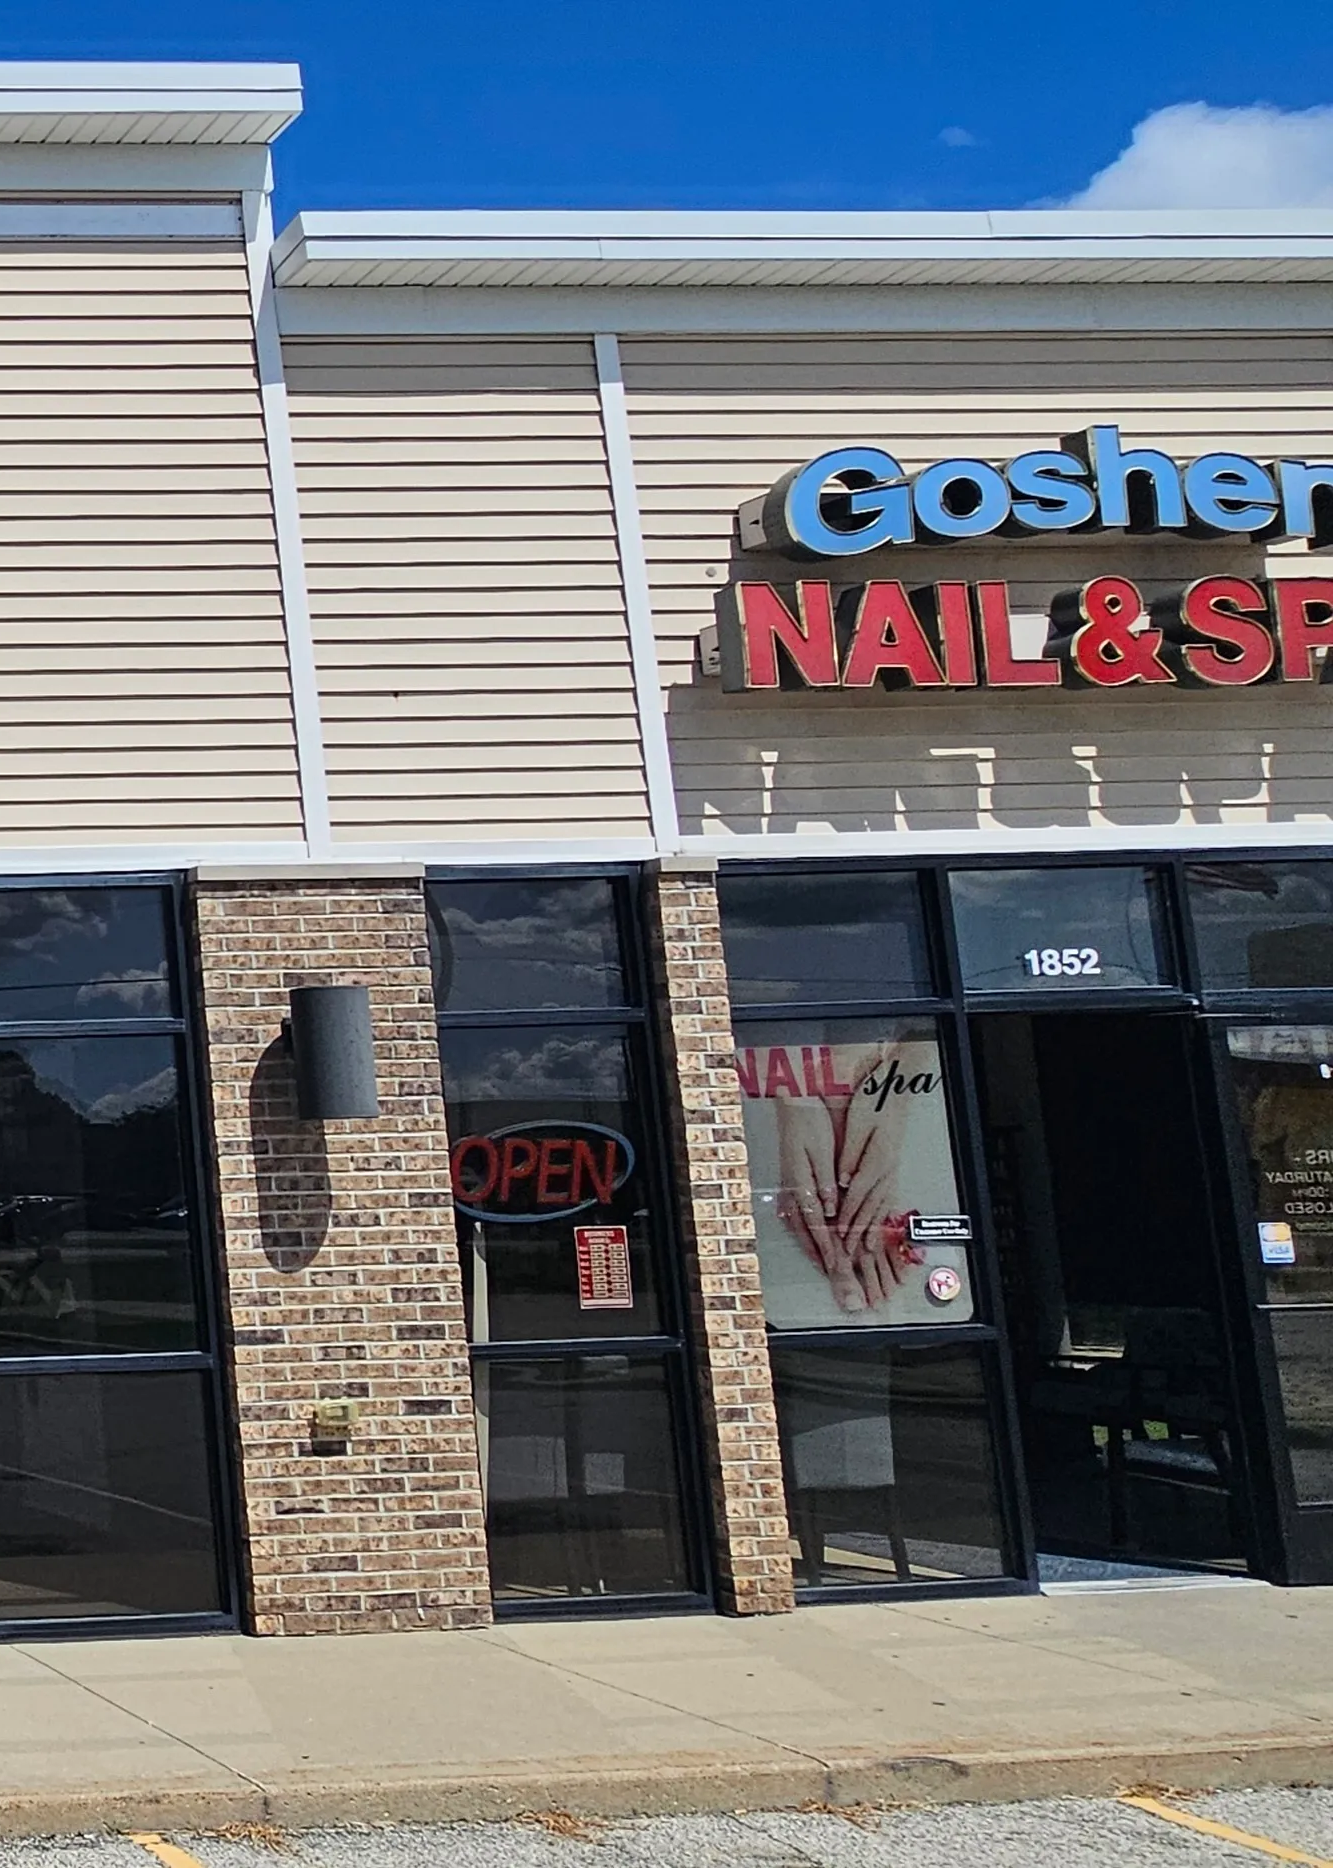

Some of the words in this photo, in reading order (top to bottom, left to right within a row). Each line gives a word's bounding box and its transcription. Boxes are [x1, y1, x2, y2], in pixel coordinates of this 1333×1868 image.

[735, 579, 1062, 689] NAIL
[1071, 575, 1177, 688] &
[1023, 948, 1101, 976] 1852
[733, 1046, 855, 1098] NAIL
[863, 1059, 942, 1113] spa
[450, 1135, 617, 1205] OPEN
